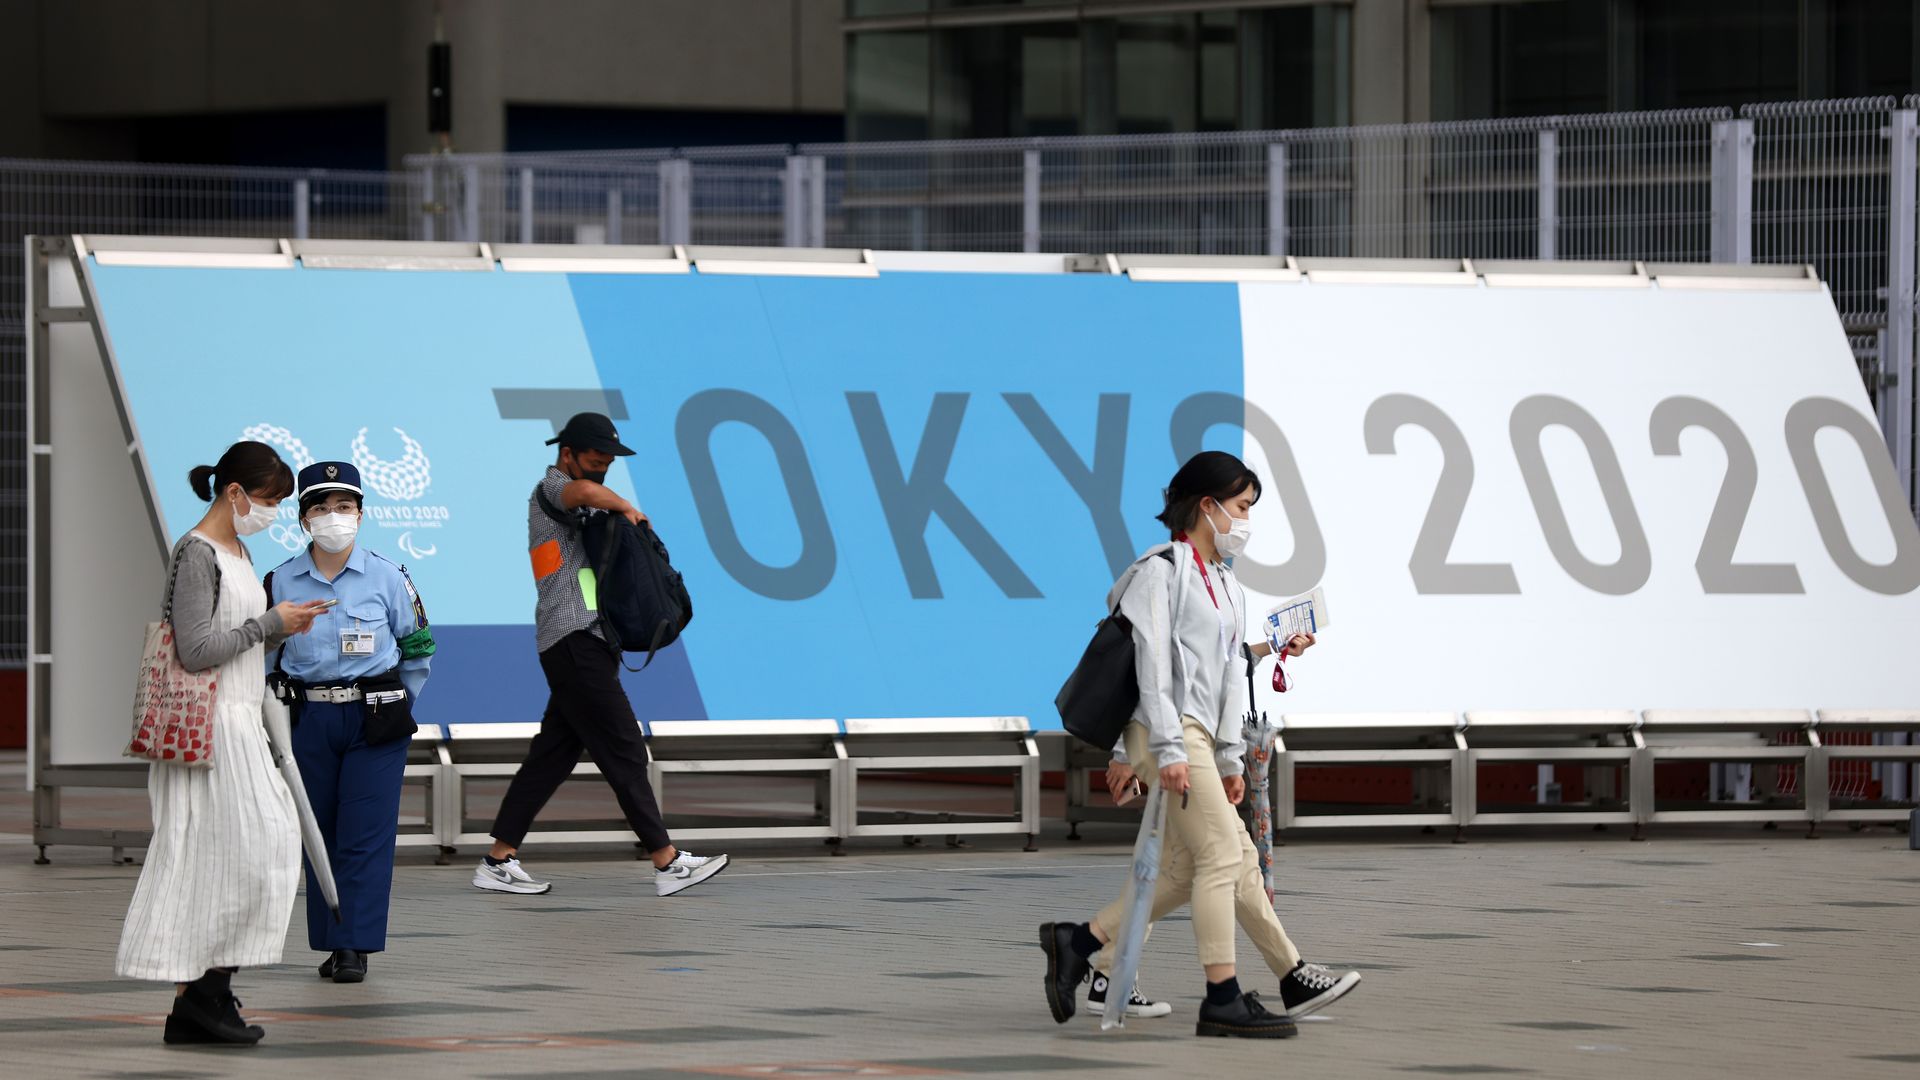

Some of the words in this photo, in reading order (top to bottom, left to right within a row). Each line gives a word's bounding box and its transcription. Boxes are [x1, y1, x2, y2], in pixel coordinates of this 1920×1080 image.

[364, 505, 412, 520] TOKYO
[412, 505, 450, 520] 2020
[1363, 392, 1920, 596] 2020
